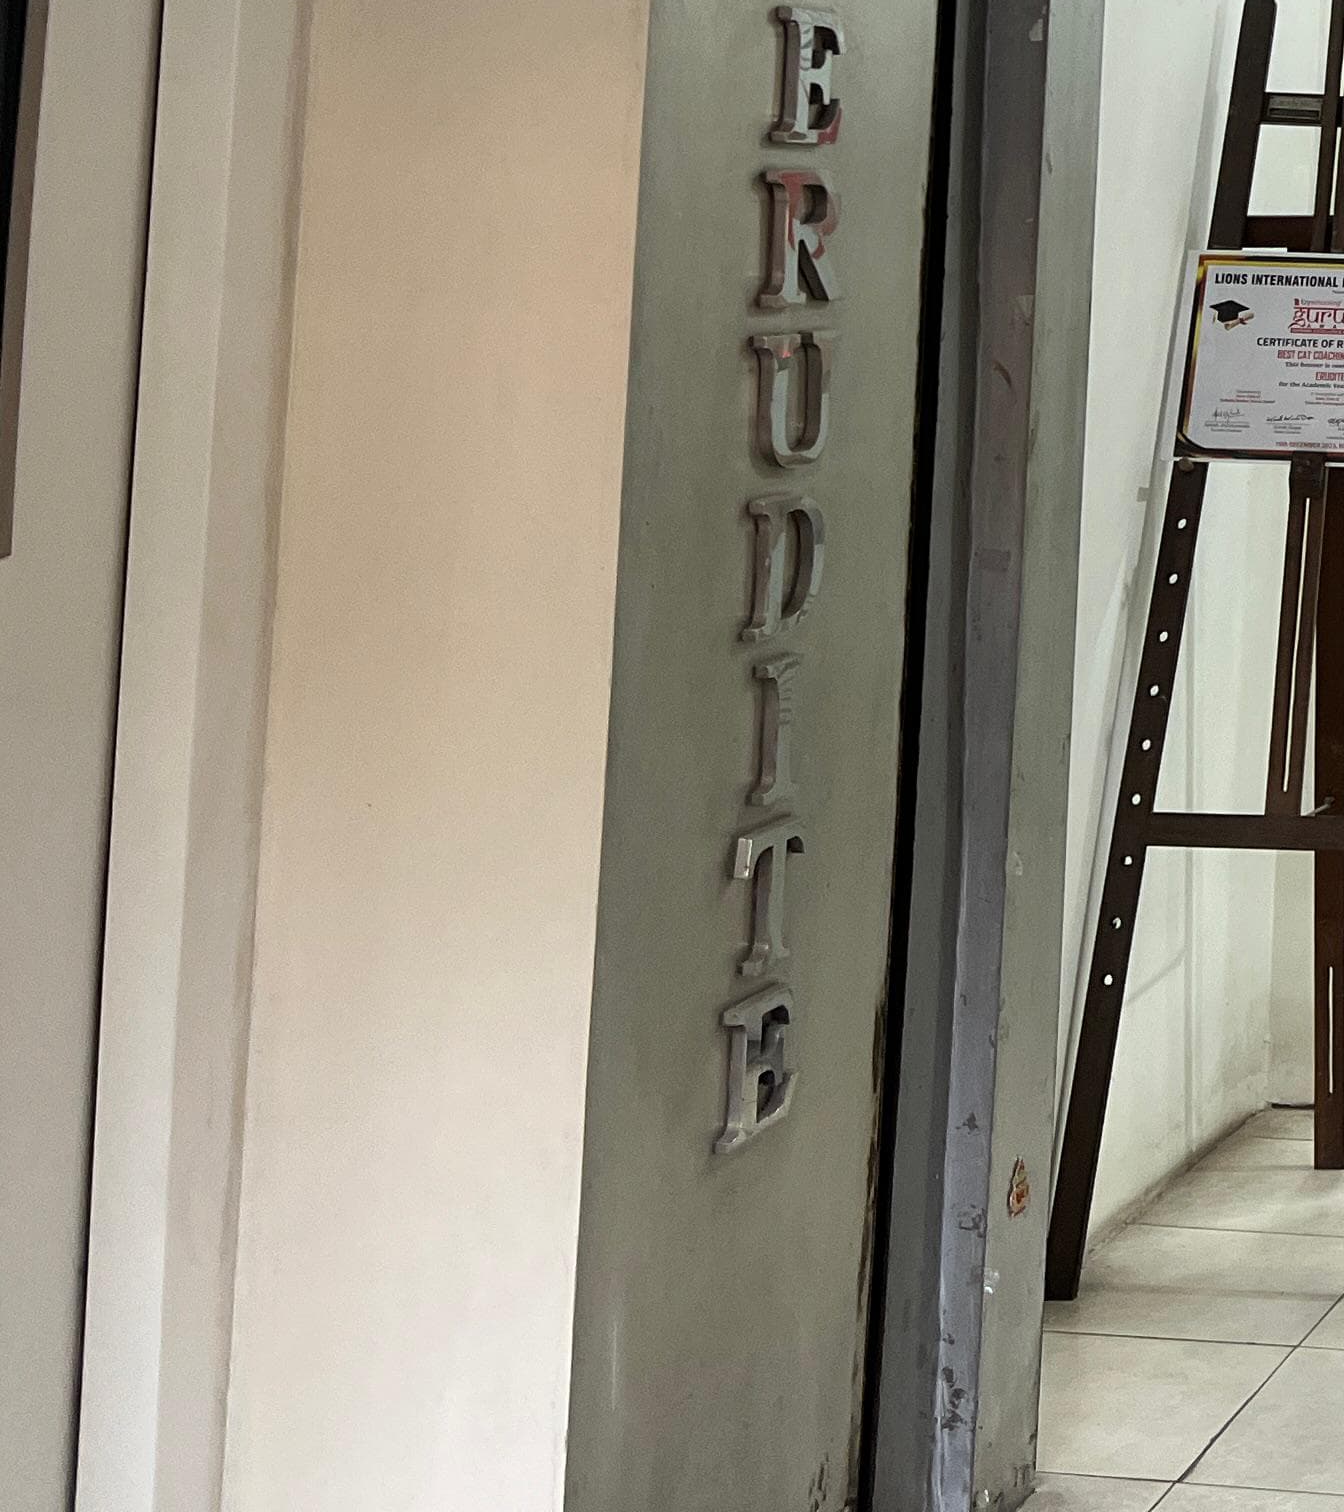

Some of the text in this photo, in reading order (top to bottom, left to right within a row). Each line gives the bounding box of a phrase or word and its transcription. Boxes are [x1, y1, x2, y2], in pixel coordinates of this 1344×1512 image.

[1215, 273, 1248, 285] LIONS
[1251, 274, 1340, 288] INTERNATIONAL
[1257, 337, 1316, 348] CERTIFICATE
[1318, 339, 1335, 349] OF
[713, 4, 844, 1156] ERUDITE
